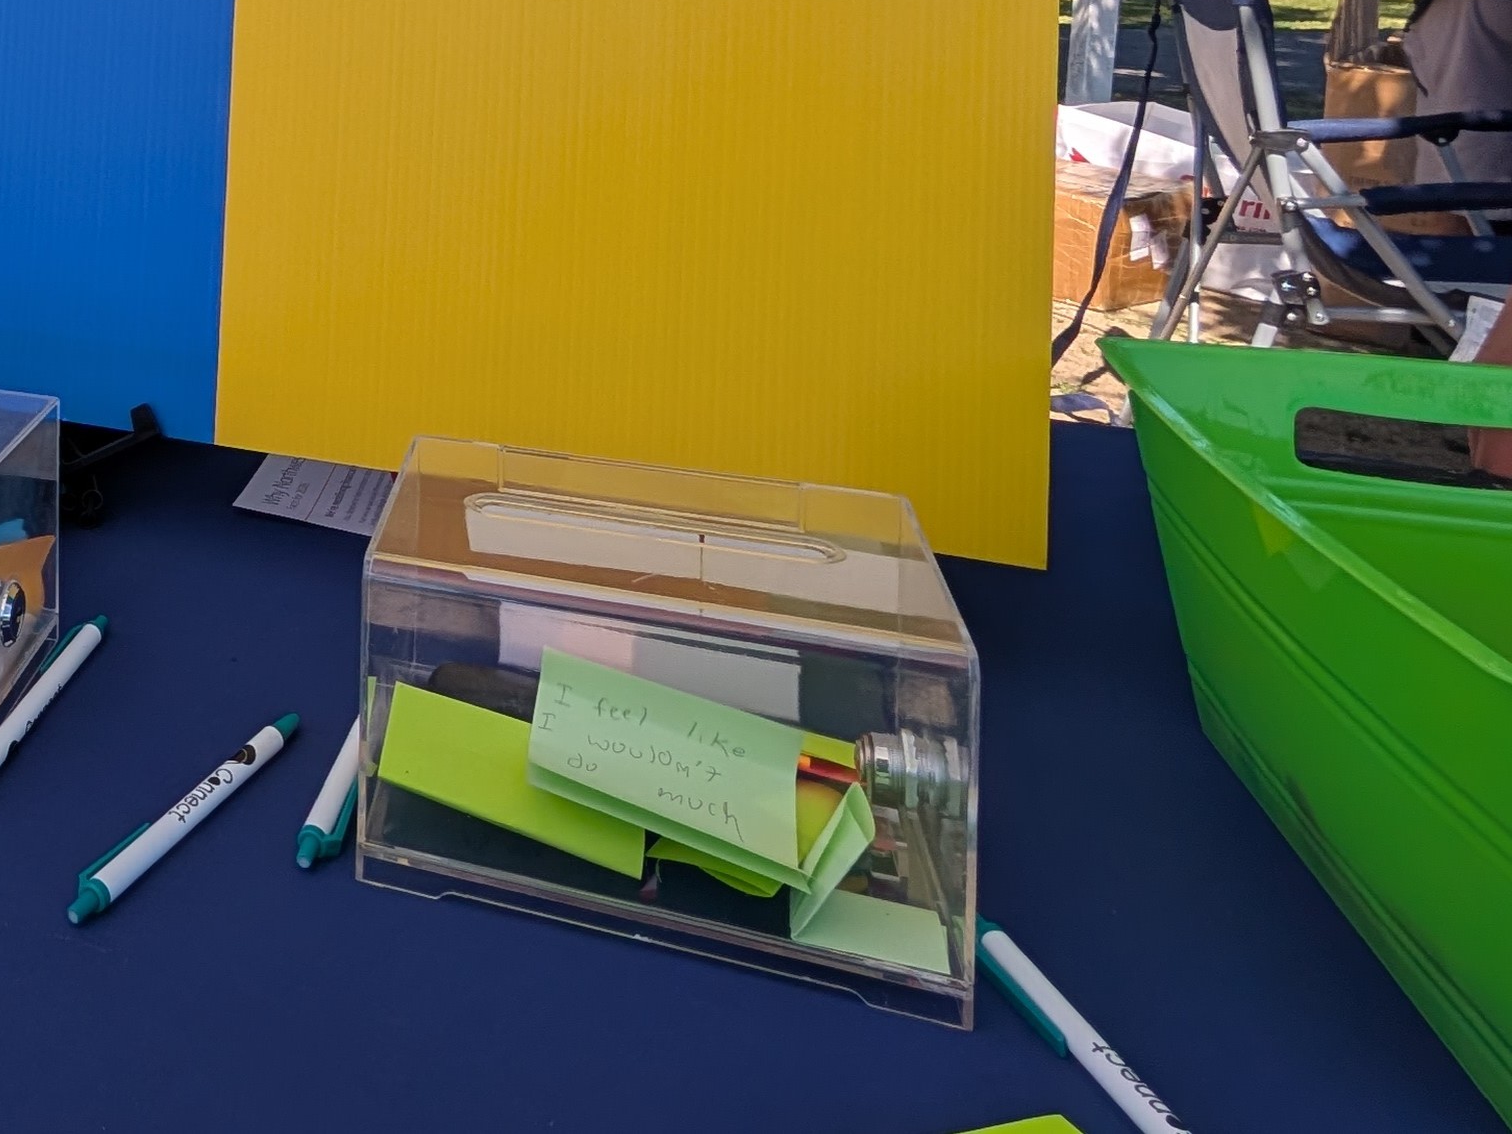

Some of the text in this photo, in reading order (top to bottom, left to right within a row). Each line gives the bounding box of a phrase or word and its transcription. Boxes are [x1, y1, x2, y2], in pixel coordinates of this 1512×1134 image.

[262, 488, 290, 506] Why
[538, 712, 556, 731] I
[554, 682, 746, 758] I feel like
[168, 765, 234, 825] Connect
[567, 753, 744, 843] do much
